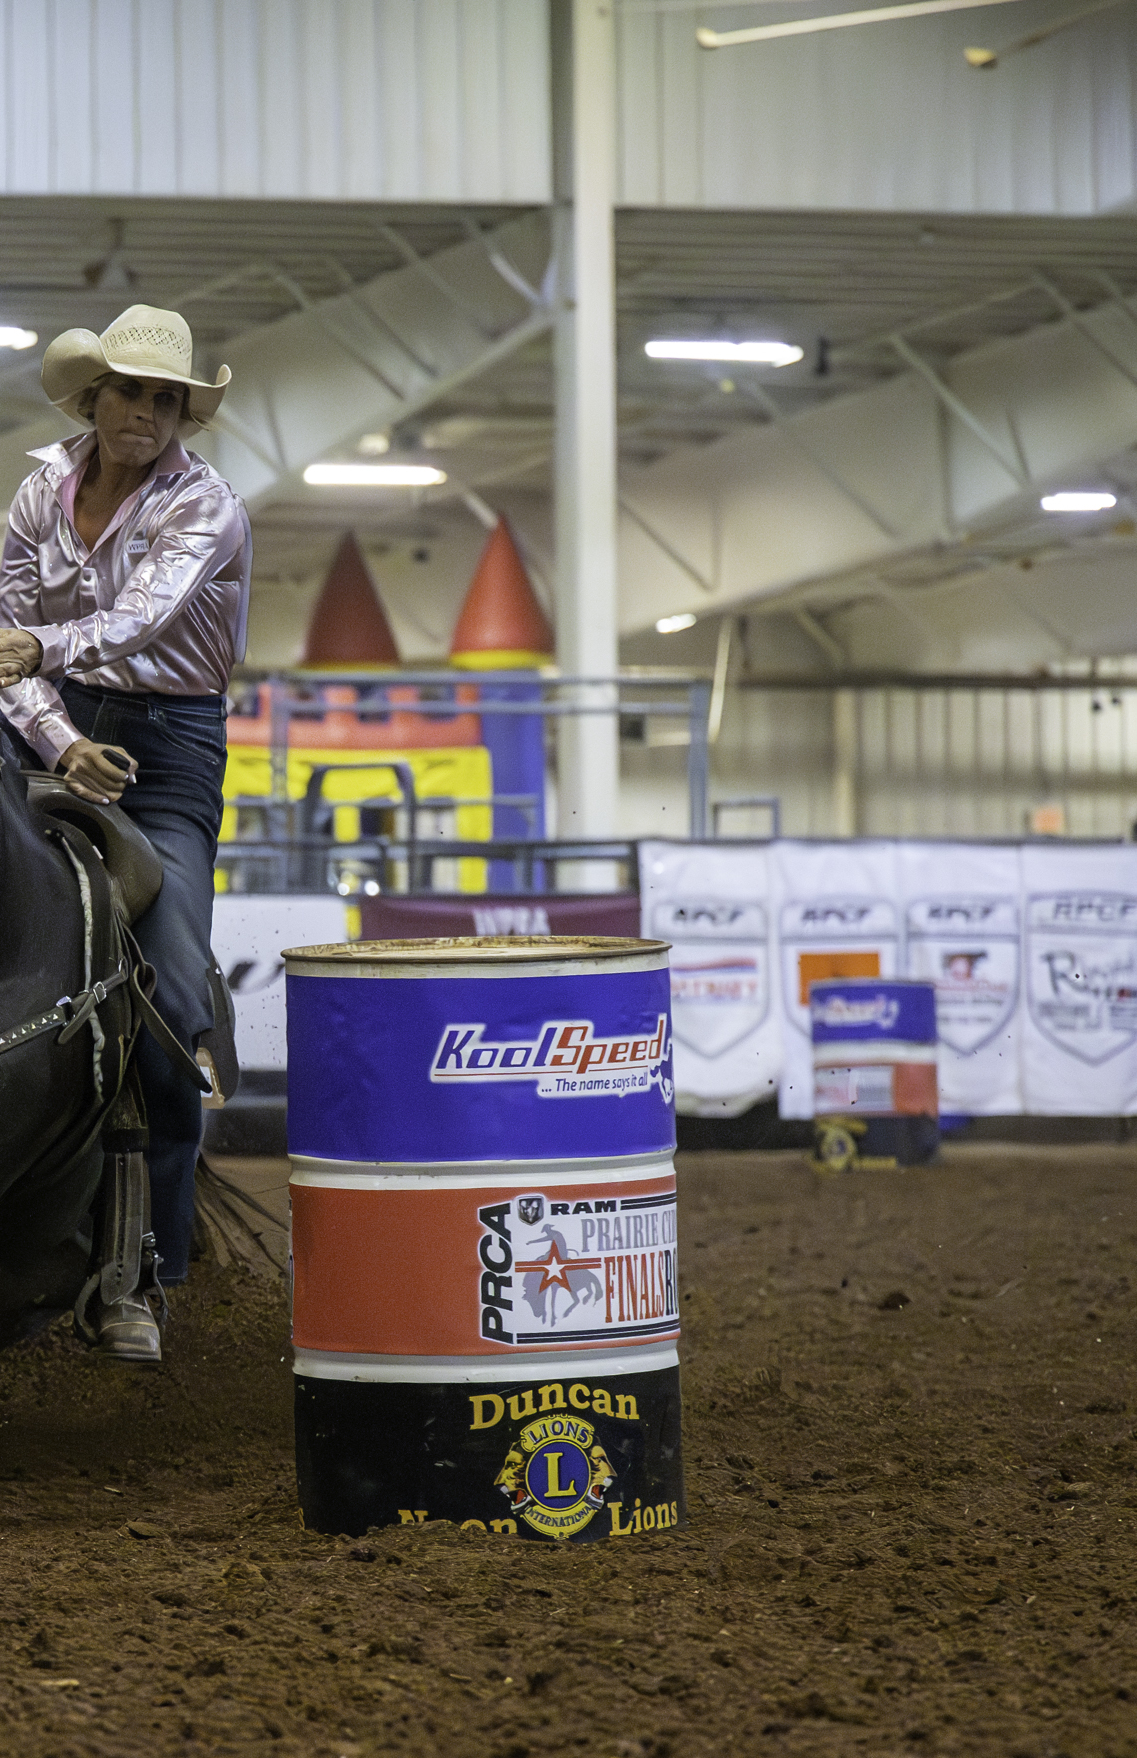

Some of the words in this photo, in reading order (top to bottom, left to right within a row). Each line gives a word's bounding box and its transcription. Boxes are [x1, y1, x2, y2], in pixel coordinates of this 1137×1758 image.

[436, 1019, 664, 1074] KoolSpeed
[555, 1078, 577, 1092] The
[578, 1078, 610, 1091] name
[612, 1076, 630, 1091] says
[631, 1074, 637, 1087] it
[638, 1071, 648, 1087] all
[551, 1200, 617, 1215] RAM
[581, 1212, 659, 1253] PRAIRIE
[479, 1202, 515, 1345] PRCA
[468, 1383, 640, 1430] Duncan
[526, 1420, 592, 1446] LIONS
[543, 1452, 577, 1498] L
[524, 1504, 592, 1528] INTERNATIONA
[607, 1498, 678, 1537] Lions
